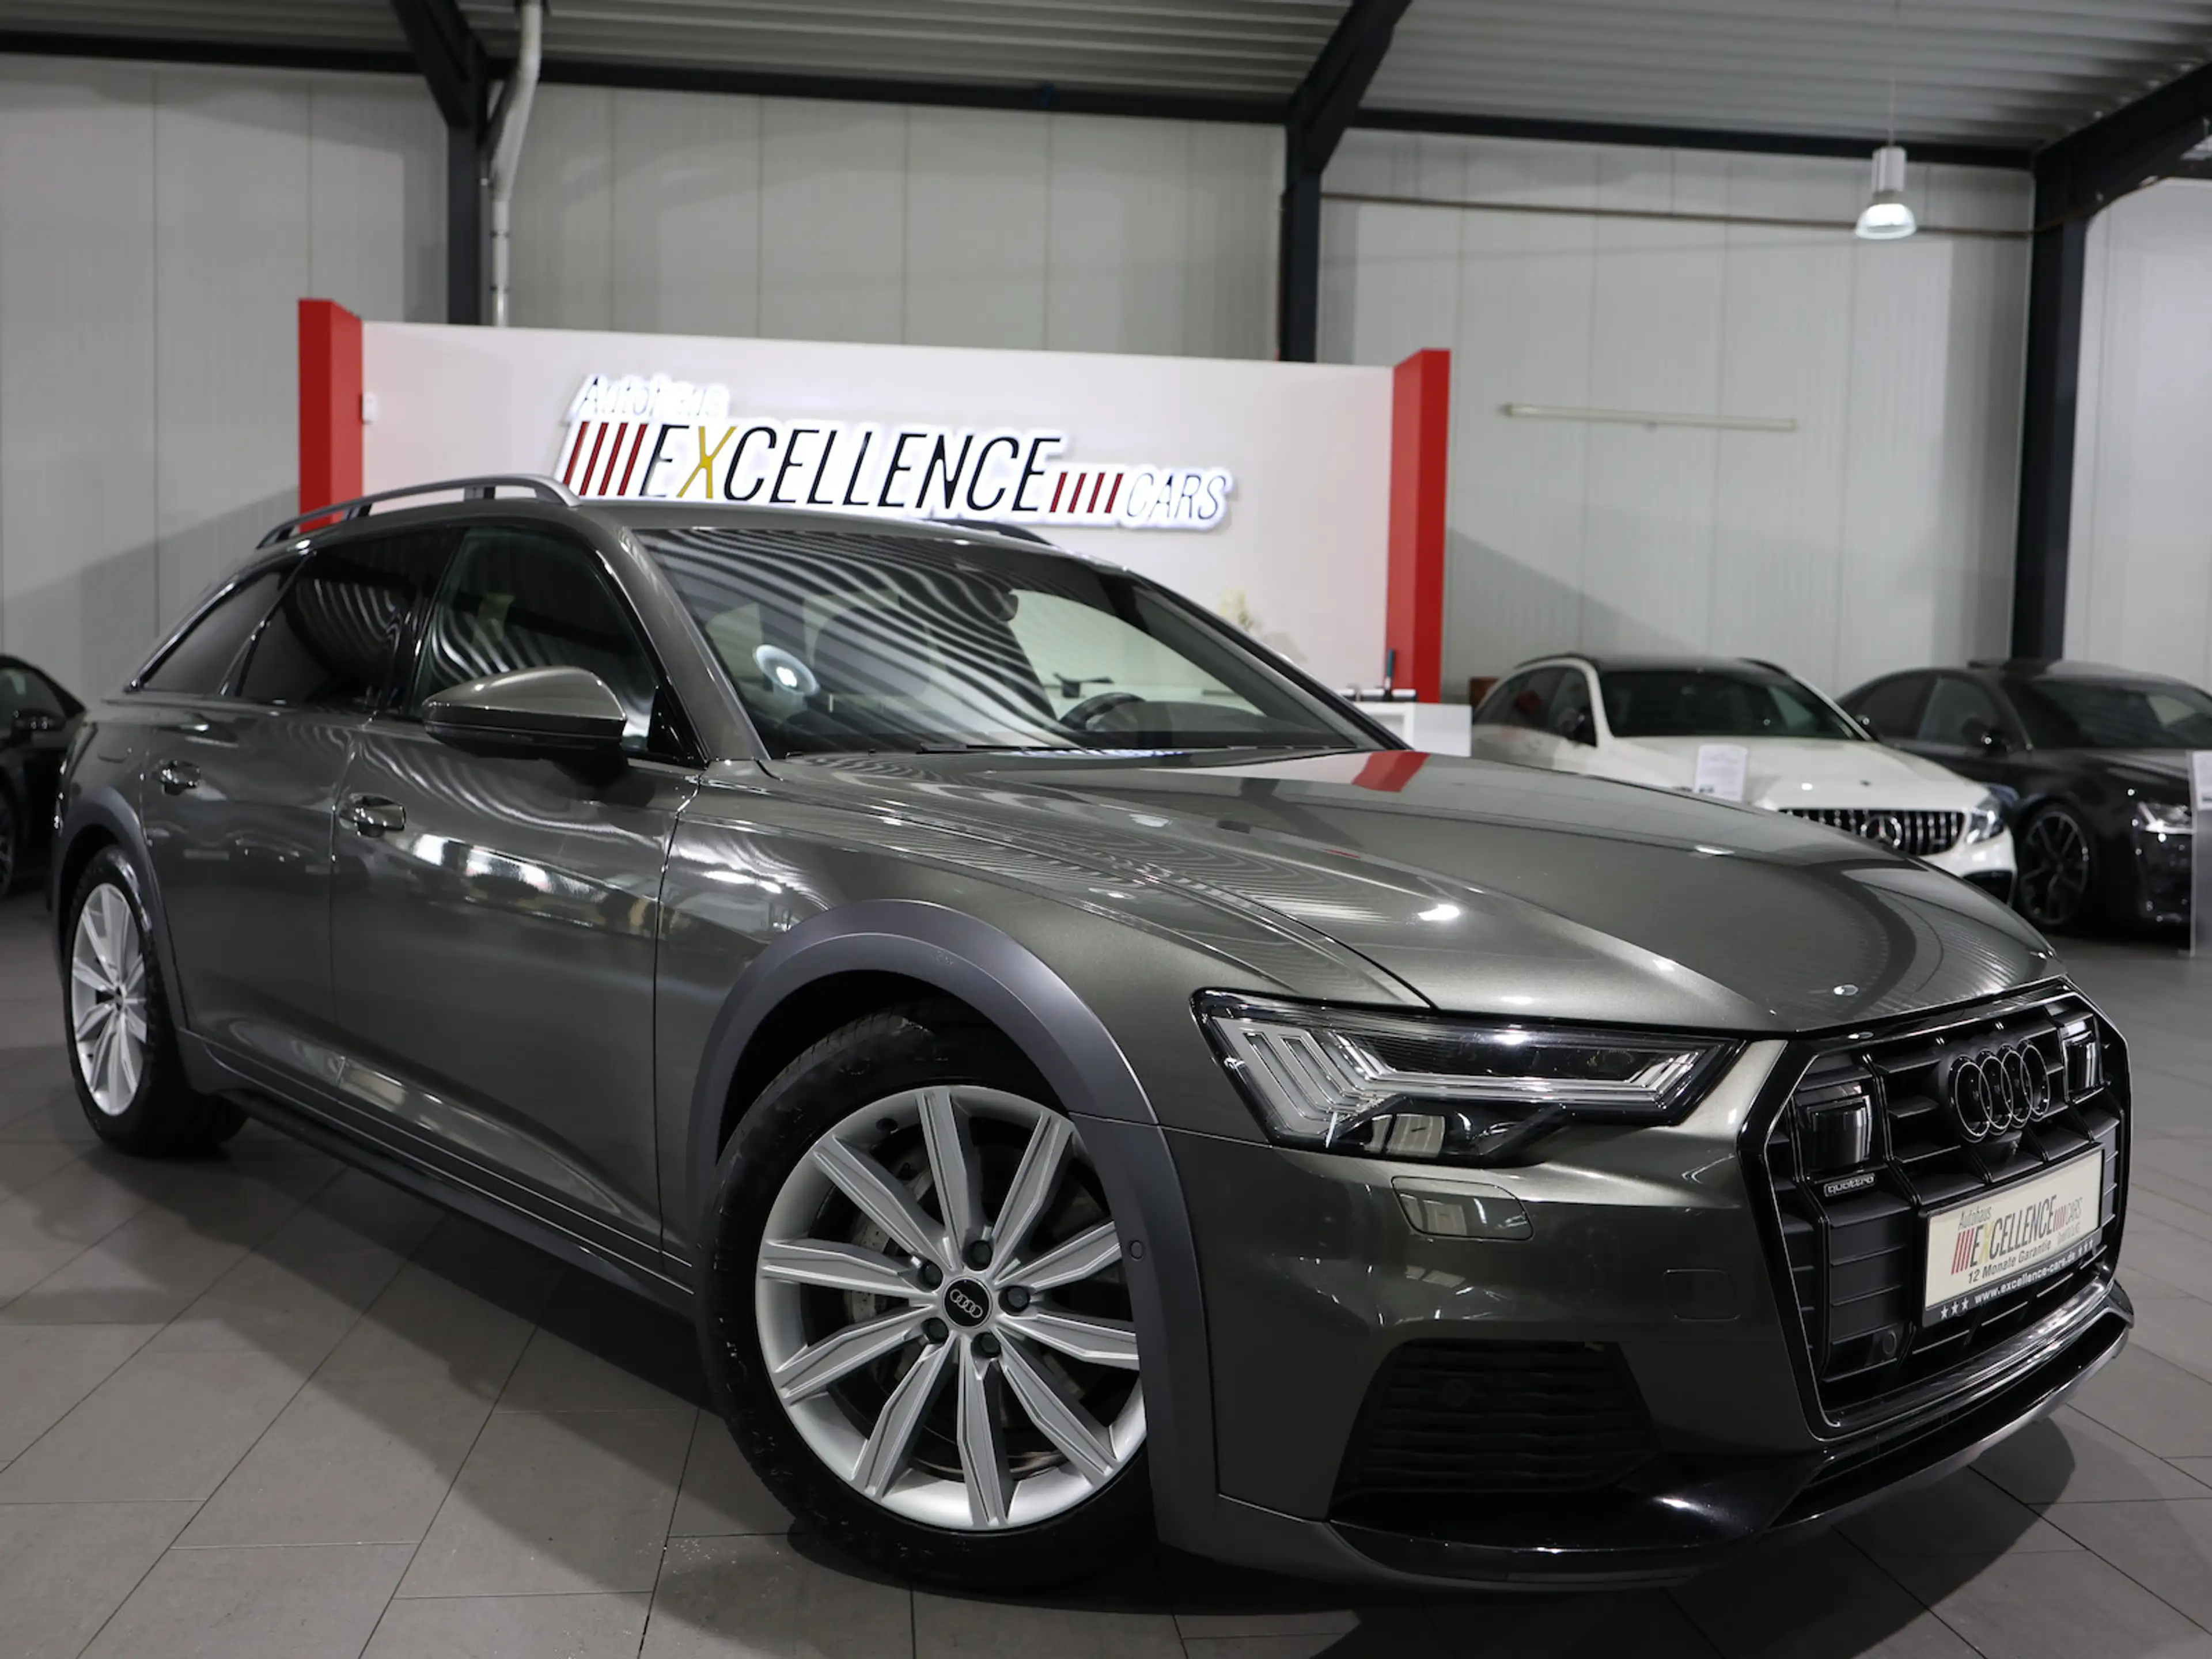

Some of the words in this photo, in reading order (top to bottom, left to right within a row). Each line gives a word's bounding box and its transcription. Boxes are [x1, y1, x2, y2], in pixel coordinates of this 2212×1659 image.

[638, 423, 1062, 512] EXCELLENCE
[1126, 471, 1227, 520] CARS
[1827, 1176, 1874, 1194] quattro
[1959, 1205, 1991, 1229] Autohaus
[1969, 1194, 2057, 1267] EXCELLENCE
[1968, 1268, 1980, 1283] 12
[1982, 1256, 2016, 1279] Monate
[2018, 1238, 2052, 1264] Garantie
[1974, 1252, 2075, 1304] www.excellence-cars.de
